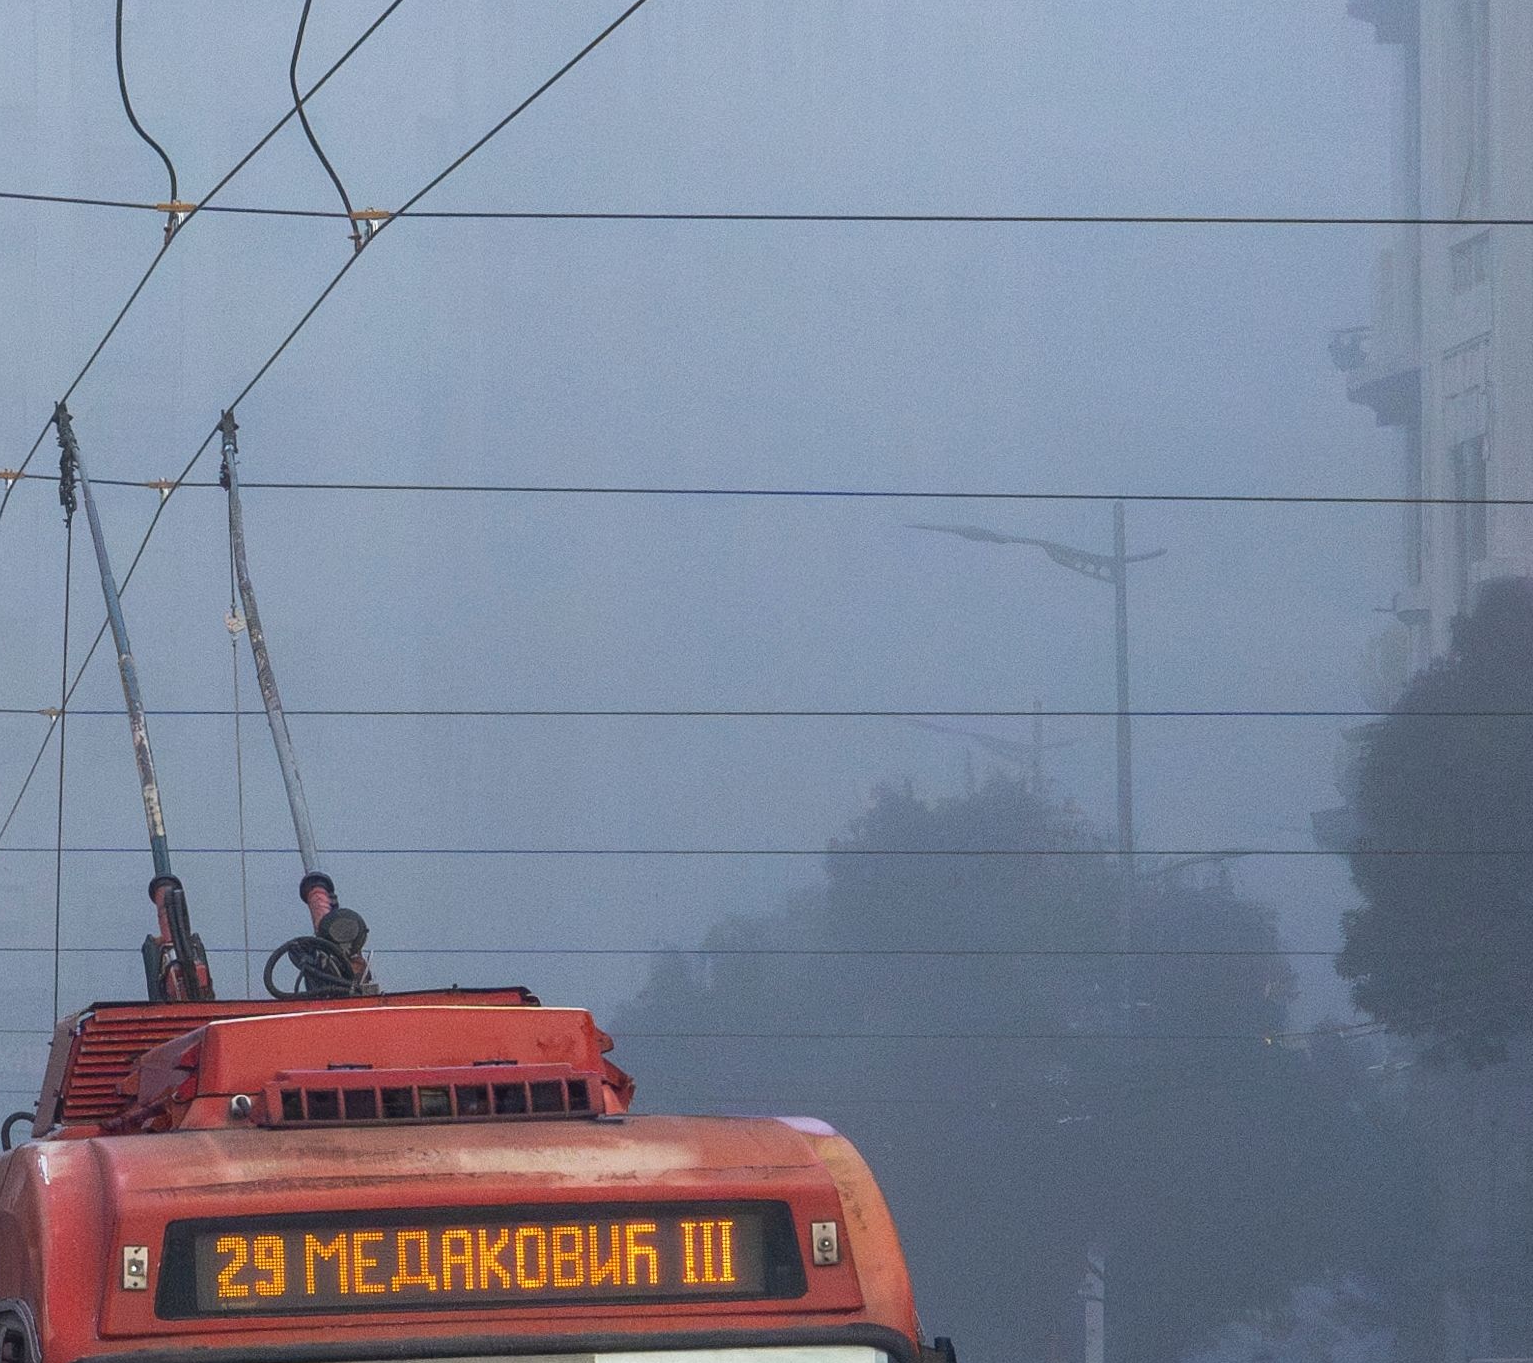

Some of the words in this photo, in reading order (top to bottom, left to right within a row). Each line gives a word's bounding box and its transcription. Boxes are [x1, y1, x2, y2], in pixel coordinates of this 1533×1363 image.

[215, 1234, 285, 1299] 29
[304, 1223, 659, 1297] МЕДАКОВИЋ
[679, 1220, 736, 1284] III
